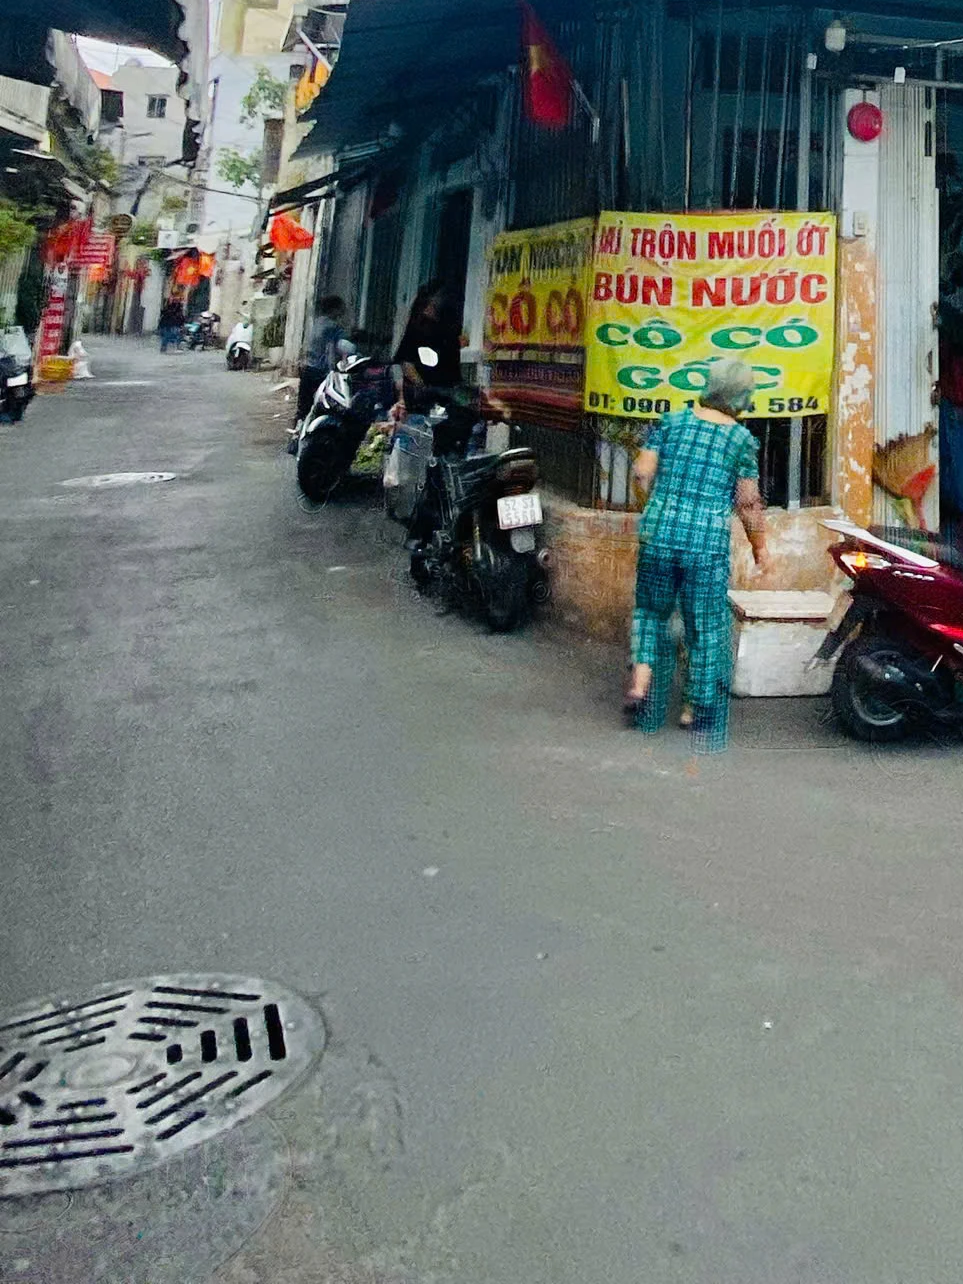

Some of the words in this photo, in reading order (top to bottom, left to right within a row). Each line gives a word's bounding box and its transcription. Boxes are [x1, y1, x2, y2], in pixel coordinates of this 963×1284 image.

[630, 222, 697, 266] TRỘN
[707, 217, 786, 260] MUỐI
[796, 220, 830, 257] ỚT
[592, 266, 673, 307] BÚN
[691, 268, 828, 307] NƯỚC
[595, 318, 682, 350] CÔ
[710, 317, 819, 350] CÓ
[767, 395, 819, 414] 584
